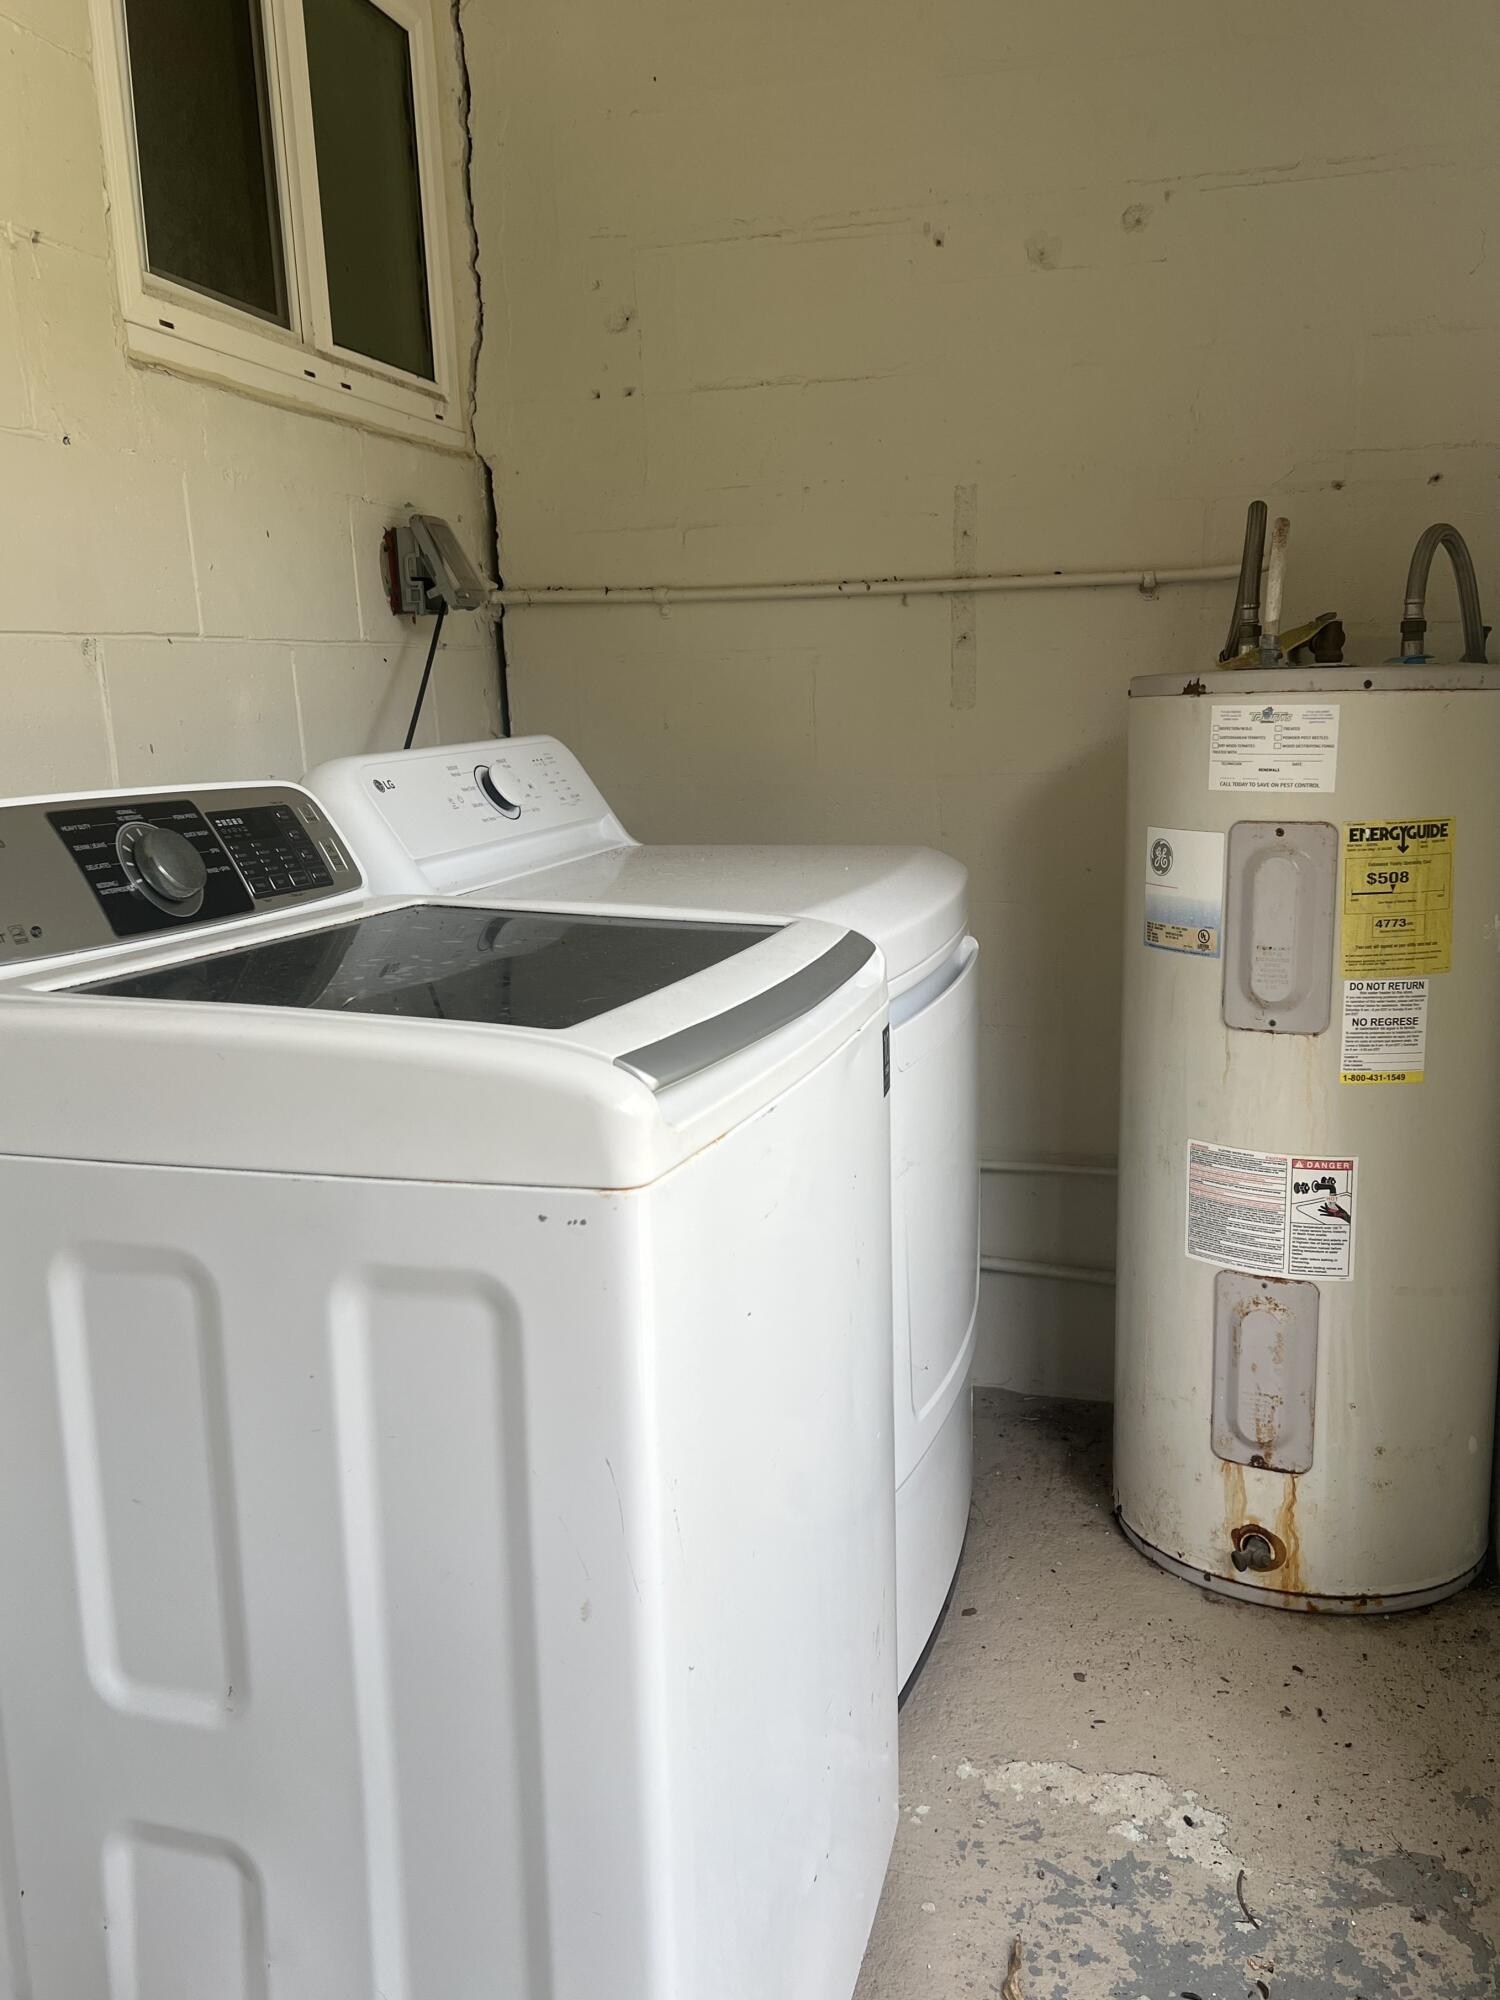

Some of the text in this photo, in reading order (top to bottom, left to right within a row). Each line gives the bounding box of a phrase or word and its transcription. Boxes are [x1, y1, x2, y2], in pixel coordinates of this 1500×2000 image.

[1366, 871, 1409, 885] $508
[1375, 918, 1406, 928] 4773
[1349, 981, 1425, 991] DO NOT RETURN
[1352, 1016, 1419, 1026] NO REGRESE
[1343, 1073, 1406, 1082] 1-800-431-1549
[1306, 1161, 1350, 1169] DANGER
